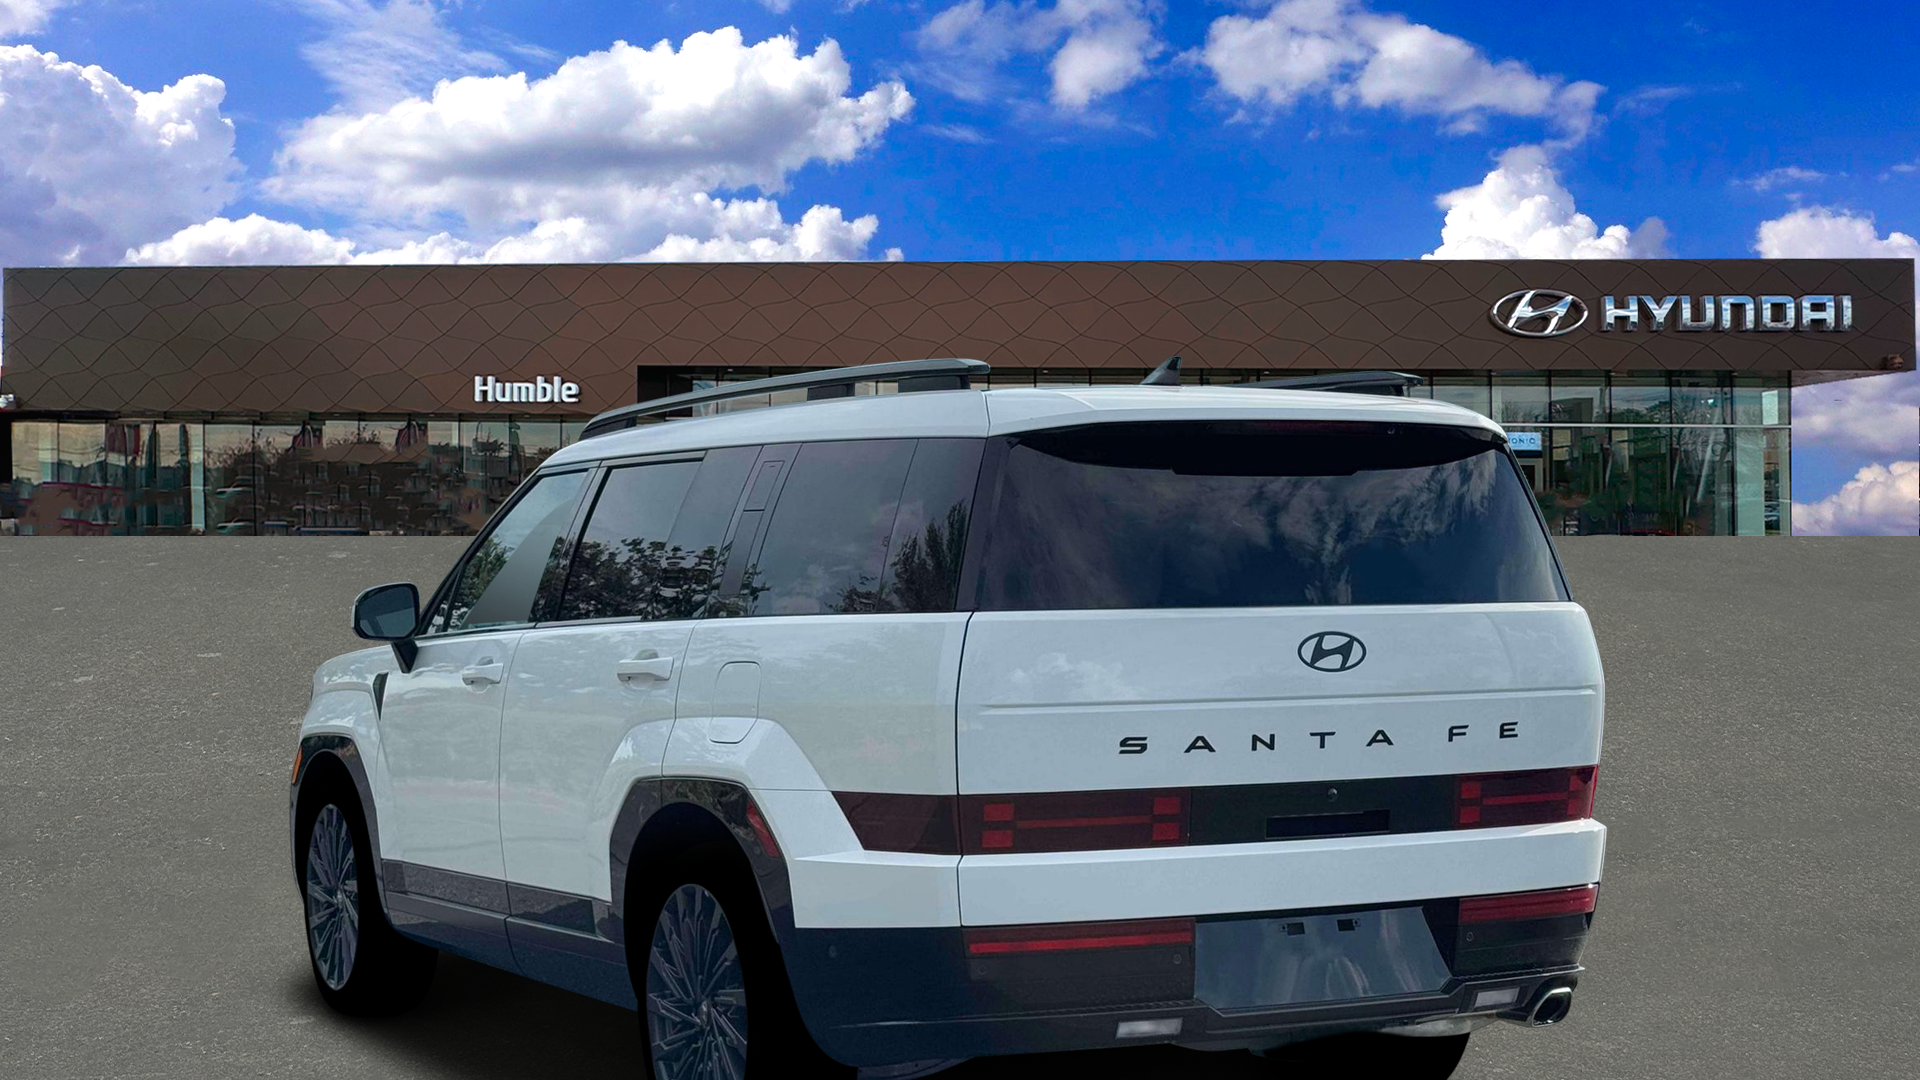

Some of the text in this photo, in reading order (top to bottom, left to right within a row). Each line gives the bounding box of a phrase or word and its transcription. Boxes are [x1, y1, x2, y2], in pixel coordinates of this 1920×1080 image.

[1601, 294, 1853, 332] HYUNDAI
[474, 375, 580, 403] Humble
[1118, 720, 1519, 755] SANTA FE
